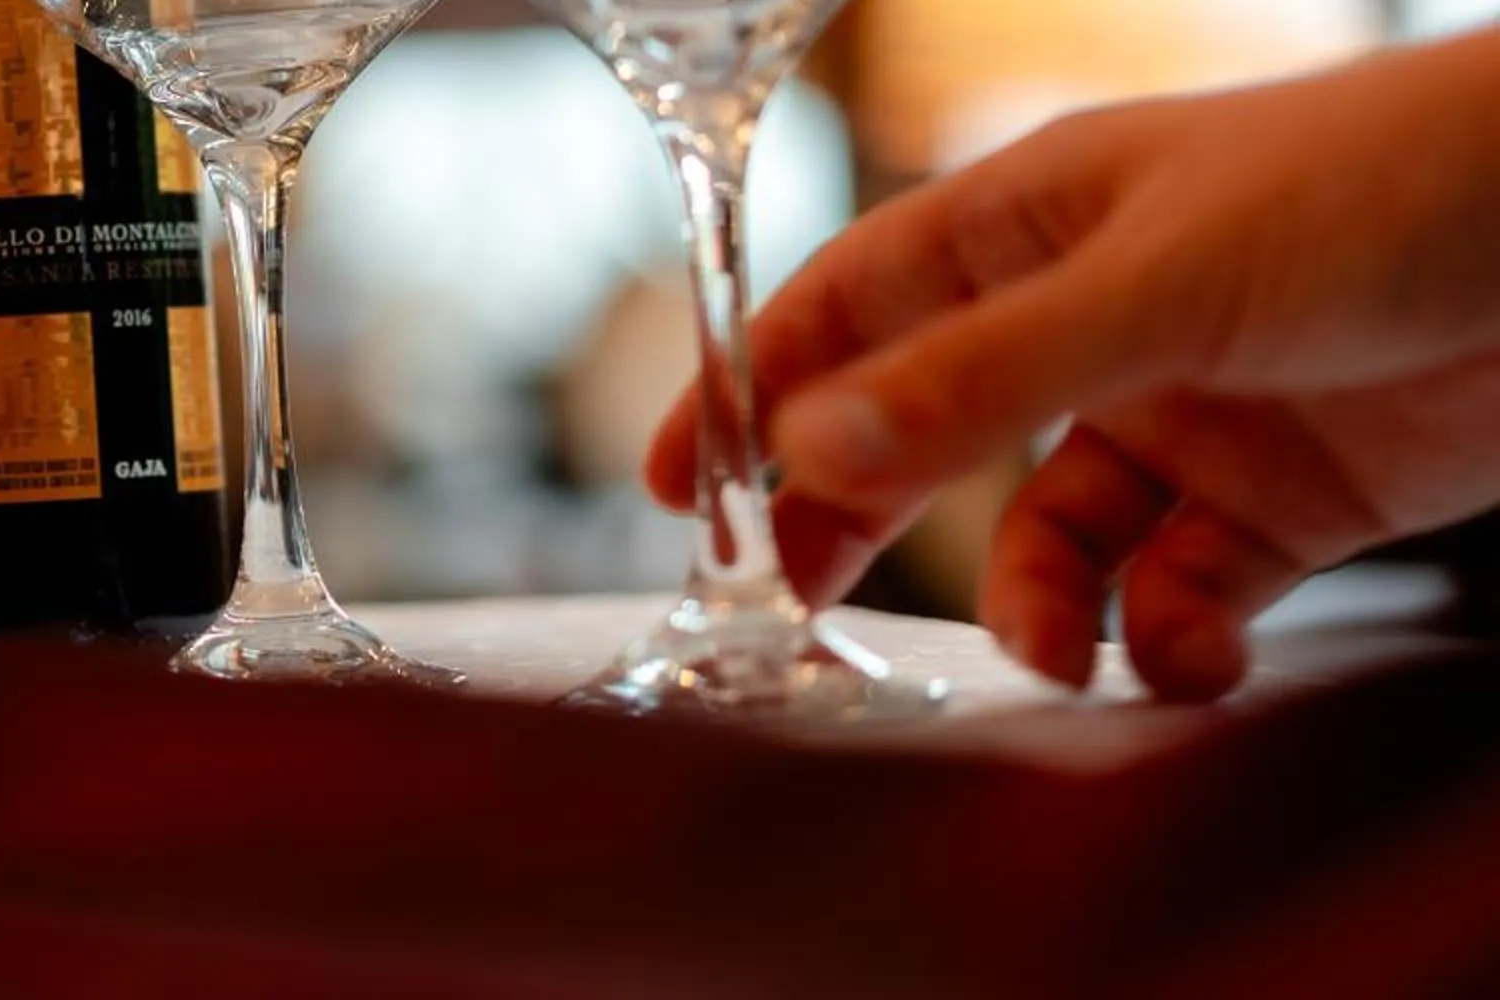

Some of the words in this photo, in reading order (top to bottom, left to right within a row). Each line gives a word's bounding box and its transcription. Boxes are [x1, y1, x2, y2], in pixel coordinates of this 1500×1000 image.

[55, 225, 87, 245] DI
[112, 309, 152, 327] 2016
[114, 458, 168, 479] GAJA
